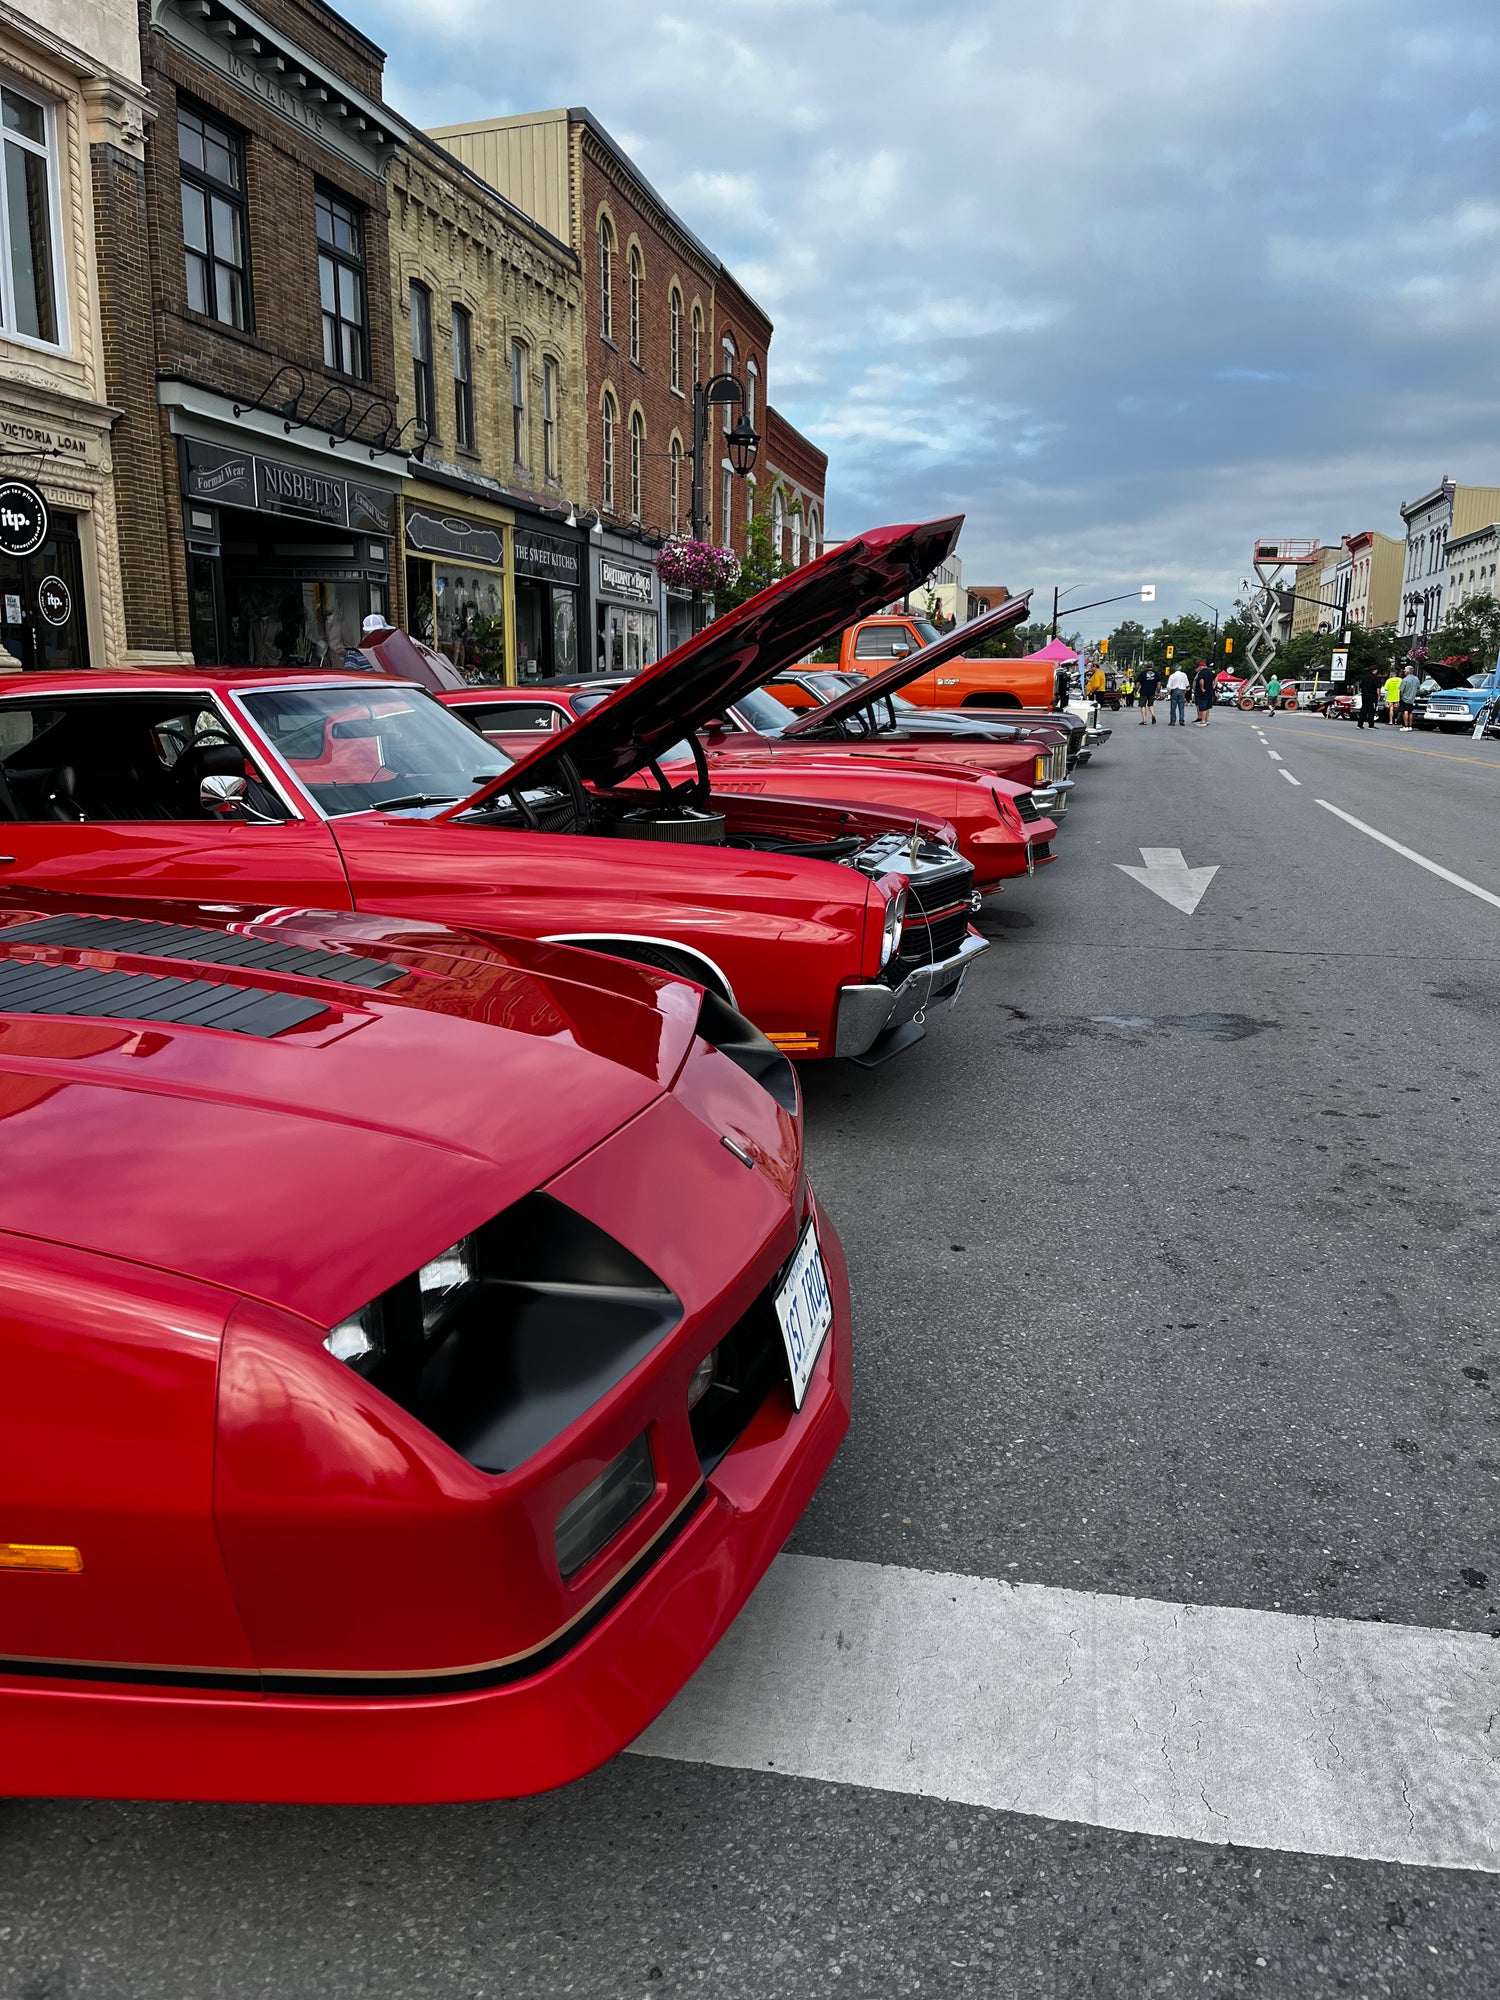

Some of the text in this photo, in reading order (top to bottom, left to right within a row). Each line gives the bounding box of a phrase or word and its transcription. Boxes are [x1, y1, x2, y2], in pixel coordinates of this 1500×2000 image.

[0, 421, 86, 453] VICTORIA LOAN
[197, 465, 246, 489] Formal Wear
[263, 465, 342, 508] NISBETT'S
[515, 544, 578, 570] THE SWEET KITCHEN
